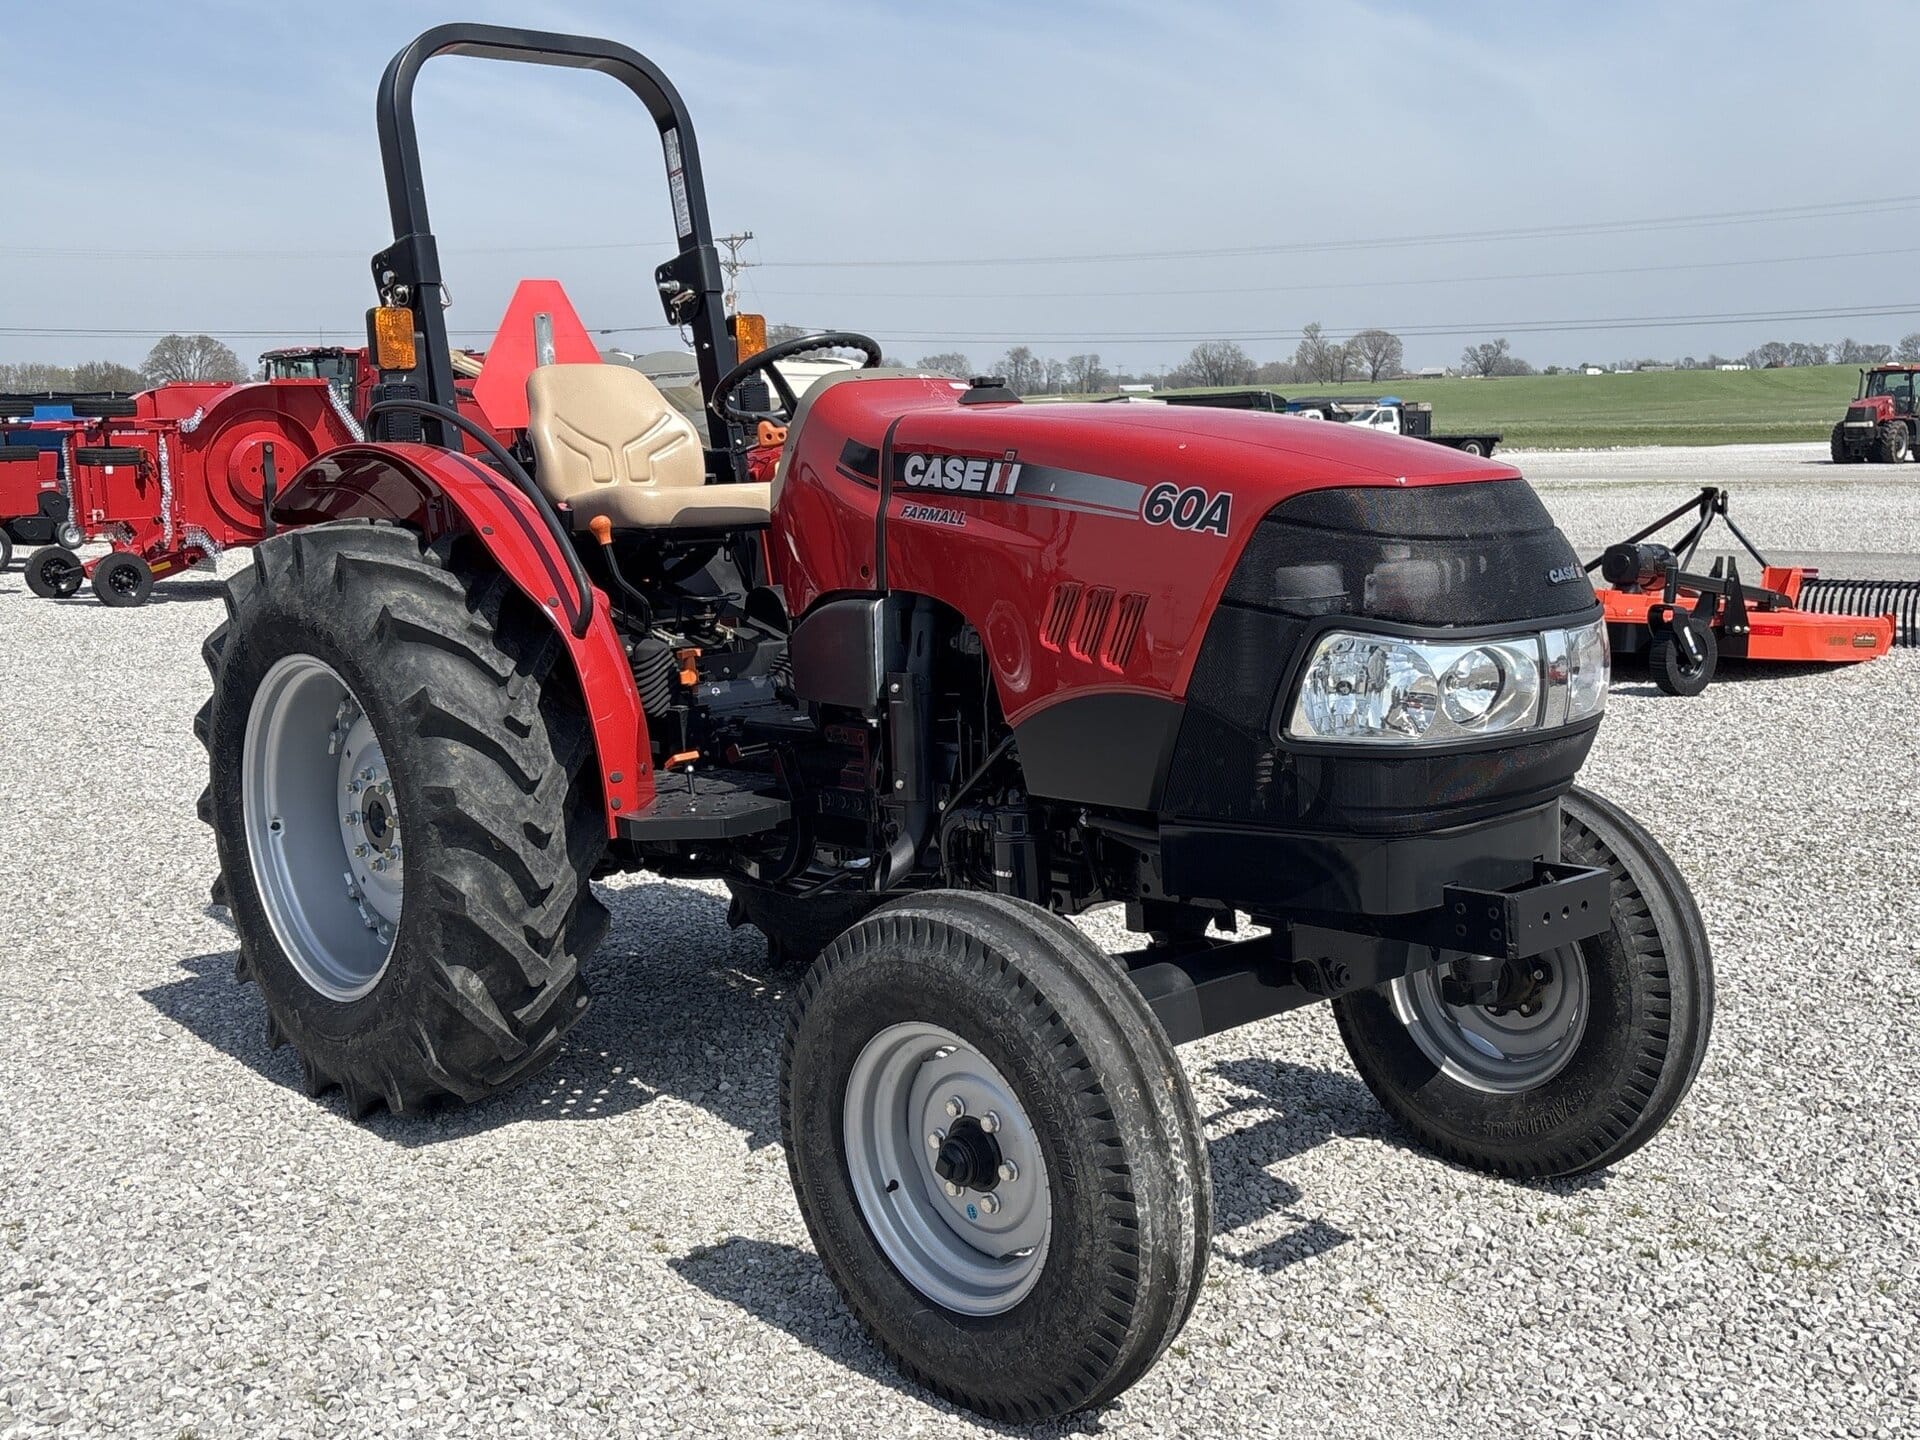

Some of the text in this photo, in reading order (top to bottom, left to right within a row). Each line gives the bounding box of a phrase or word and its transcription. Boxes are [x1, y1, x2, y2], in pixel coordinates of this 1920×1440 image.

[904, 454, 986, 493] CASE
[900, 505, 967, 527] FARMALL
[1143, 481, 1232, 538] 60A
